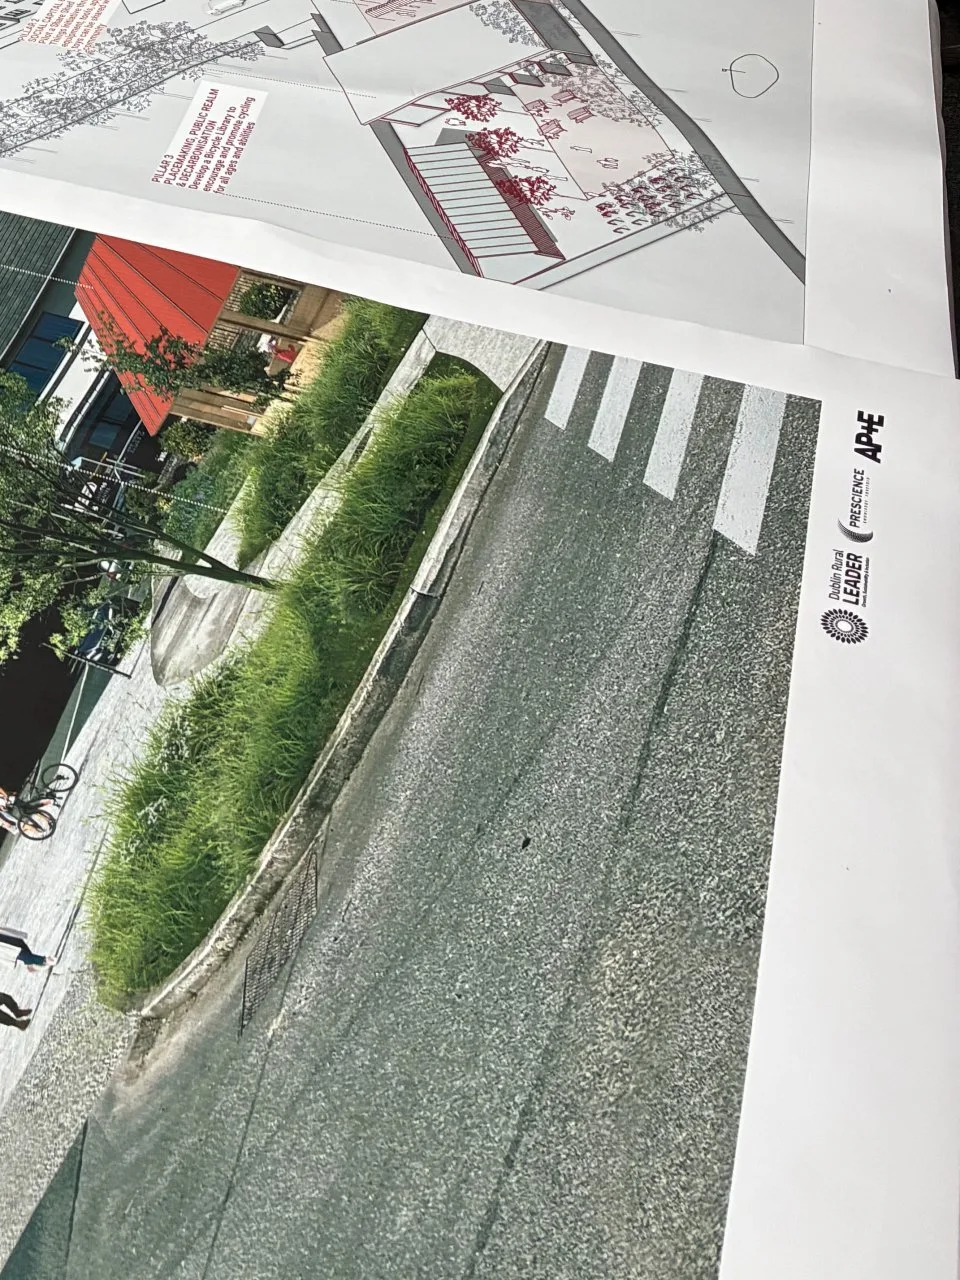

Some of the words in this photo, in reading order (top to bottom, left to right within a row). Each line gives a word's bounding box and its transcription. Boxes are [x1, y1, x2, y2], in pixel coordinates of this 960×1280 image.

[188, 112, 208, 136] PUBLIC
[200, 88, 220, 112] REALM
[234, 96, 256, 120] cycling
[225, 119, 244, 147] promote
[237, 121, 255, 147] abilities
[187, 164, 211, 190] Develop
[203, 136, 223, 159] Bicycle
[215, 113, 236, 136] Library
[219, 145, 231, 159] and
[232, 146, 244, 160] and
[151, 159, 172, 183] PILLAR
[202, 159, 226, 192] encourage
[219, 175, 231, 185] all
[224, 159, 238, 176] ages
[212, 184, 226, 195] for
[854, 410, 885, 464] AP+E
[849, 468, 865, 528] PRESCIENCE
[832, 549, 844, 571] Rural
[829, 573, 841, 601] Dublin
[843, 552, 863, 606] LEADER
